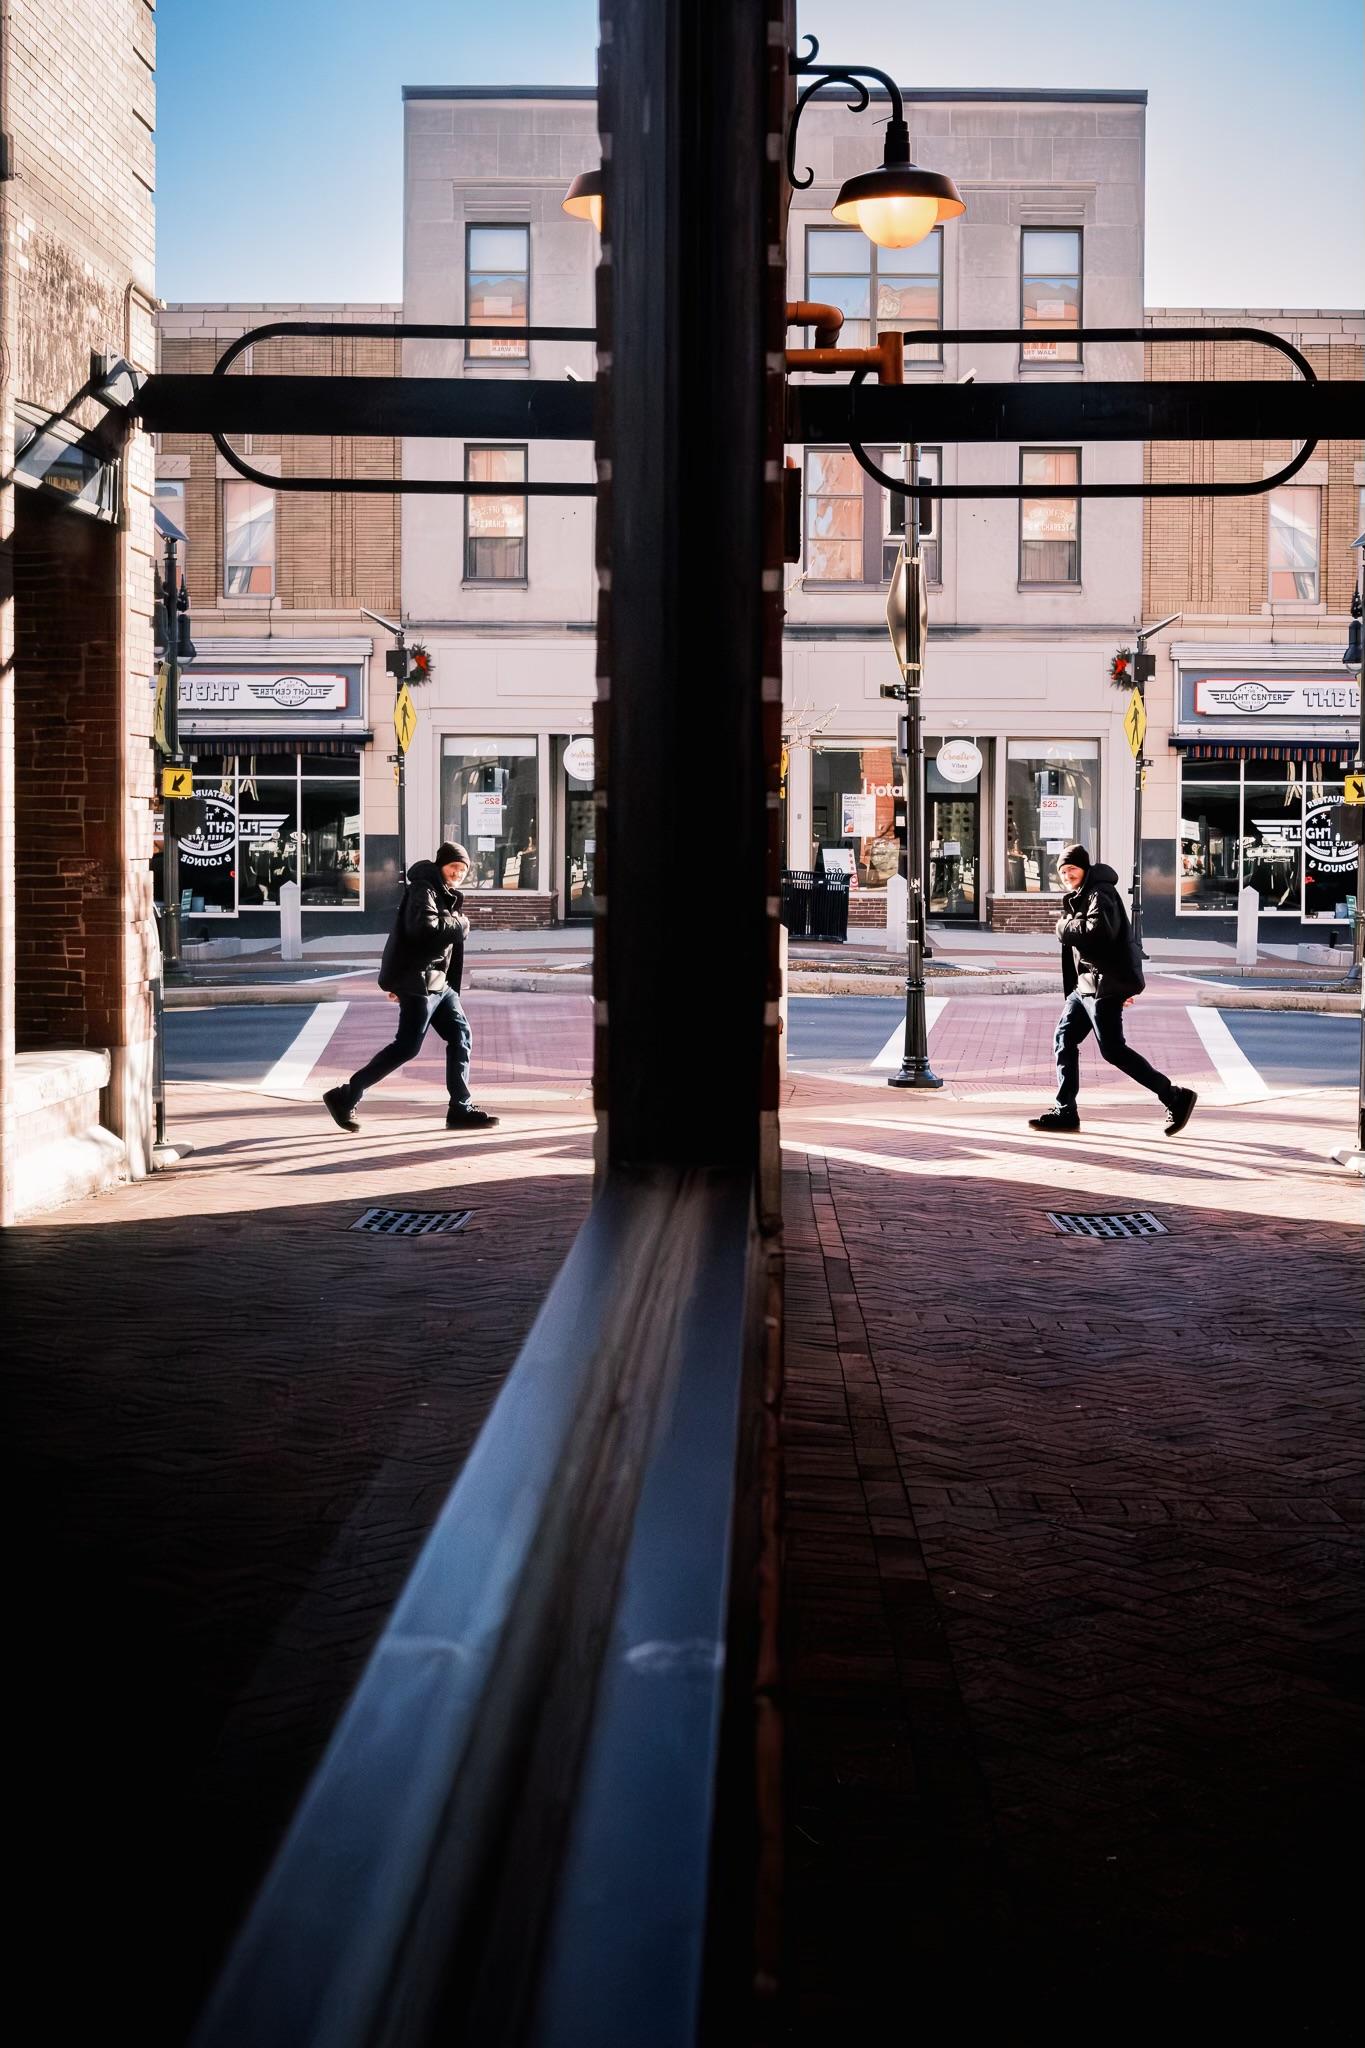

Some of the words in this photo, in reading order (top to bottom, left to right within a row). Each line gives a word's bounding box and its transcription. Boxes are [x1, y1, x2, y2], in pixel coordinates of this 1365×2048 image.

[1220, 693, 1249, 701] FLIGHT
[1251, 693, 1282, 701] CENTER
[1302, 688, 1346, 707] THE
[1042, 800, 1058, 808] $25
[1281, 827, 1331, 840] FLIGHT
[1308, 860, 1316, 868] &
[1317, 860, 1359, 873] LOUNGE
